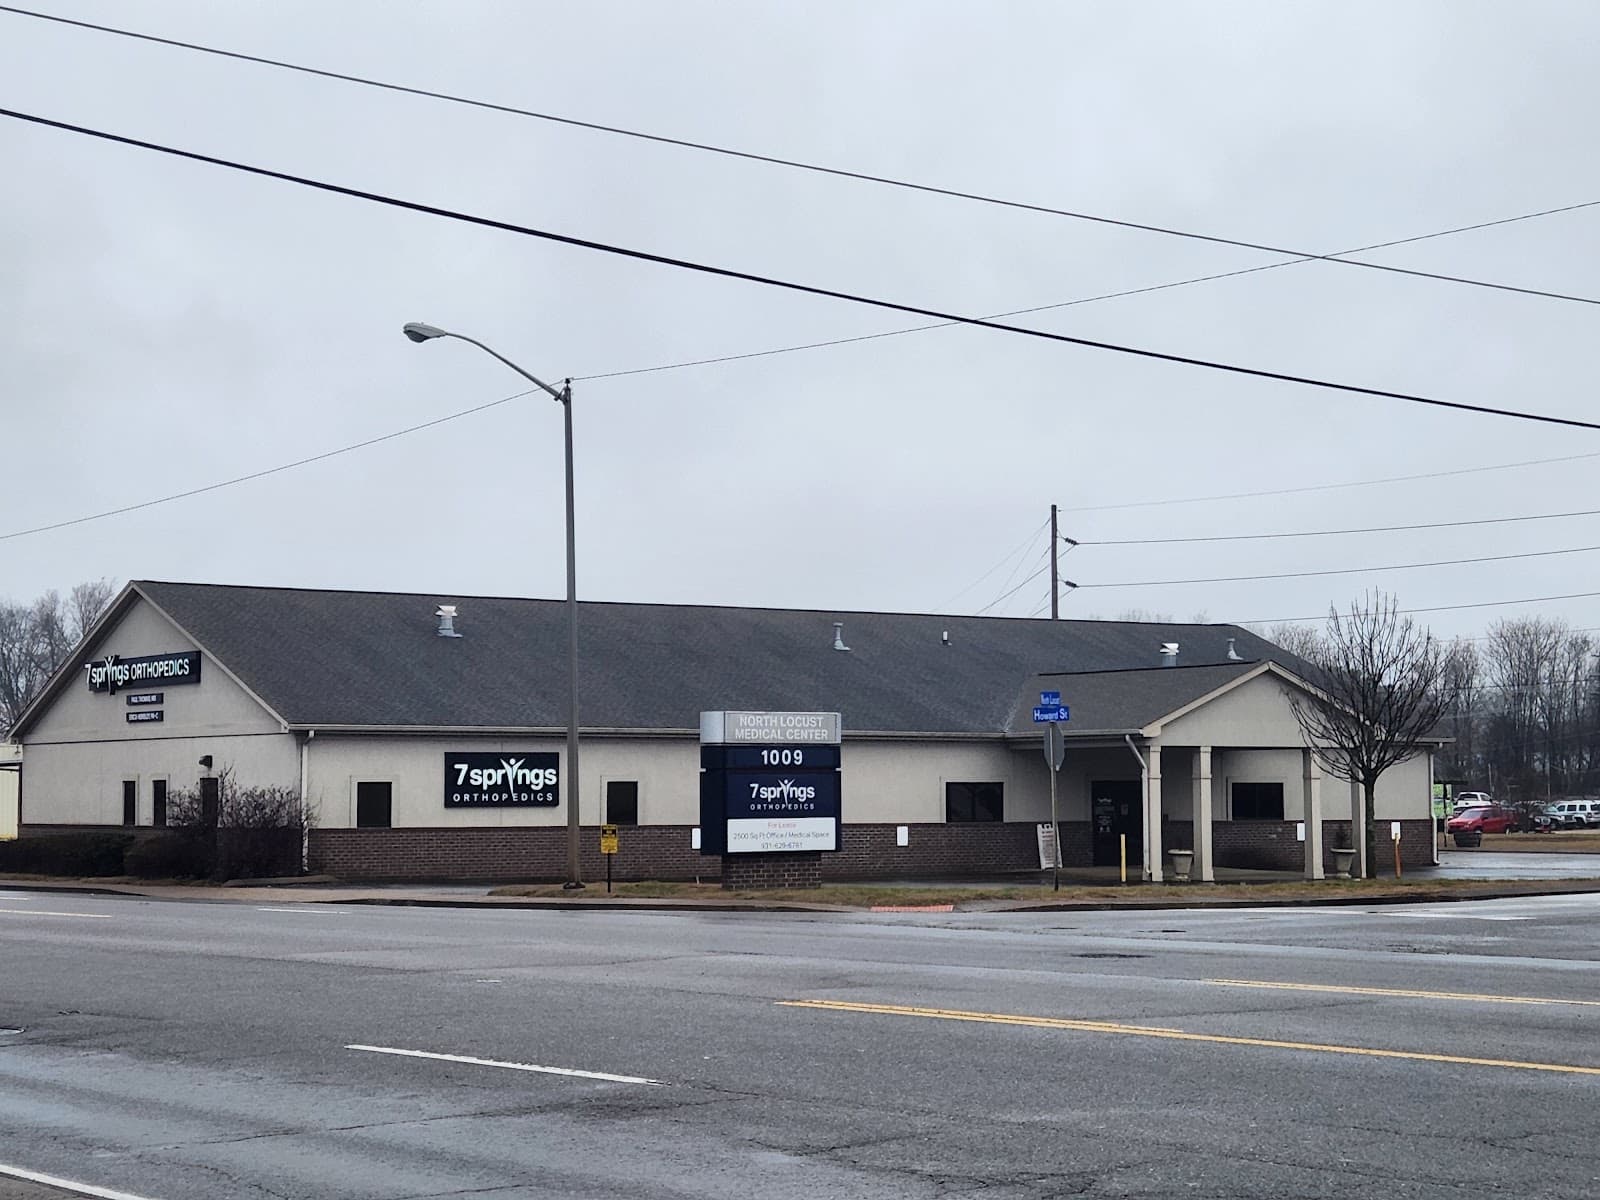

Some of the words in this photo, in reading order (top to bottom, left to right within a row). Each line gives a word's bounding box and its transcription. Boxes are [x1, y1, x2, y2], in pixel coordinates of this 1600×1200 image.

[131, 659, 189, 680] ORTHOPEDICS
[740, 716, 777, 728] NORTH
[780, 716, 823, 728] LOCUST
[735, 729, 784, 740] MEDICAL
[786, 729, 828, 740] CENTER
[761, 749, 803, 765] 1009
[453, 793, 553, 802] ORTHOPEDICS
[750, 803, 815, 811] ORTHOPEDICS
[733, 832, 749, 840] 2500
[766, 832, 783, 840] Office
[789, 831, 810, 839] Medical
[812, 831, 830, 839] Space
